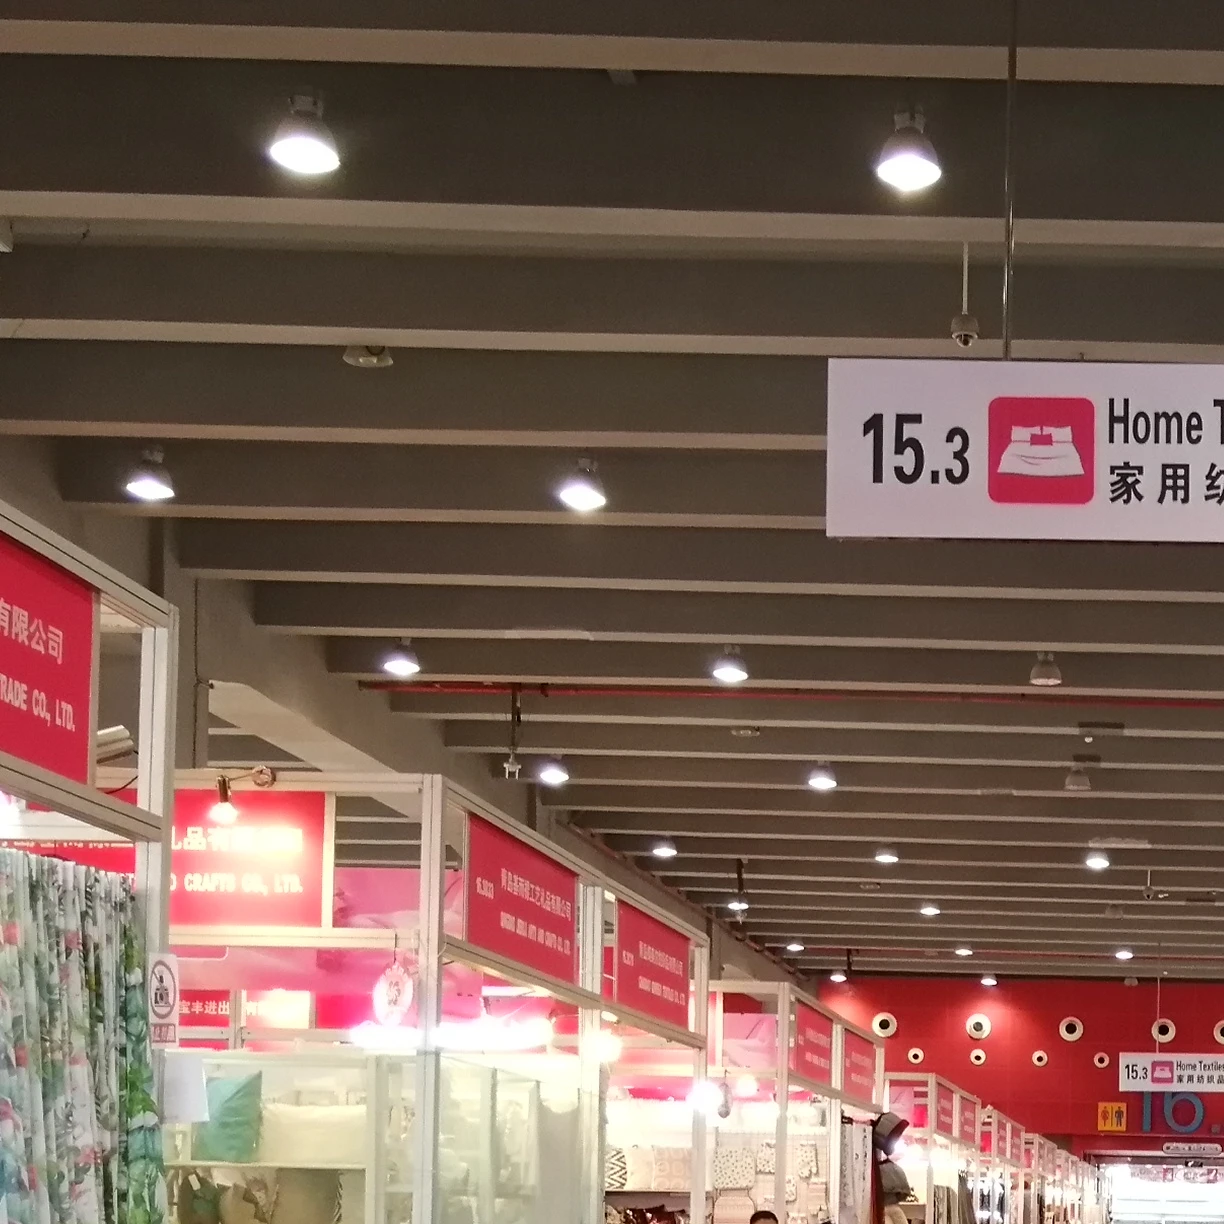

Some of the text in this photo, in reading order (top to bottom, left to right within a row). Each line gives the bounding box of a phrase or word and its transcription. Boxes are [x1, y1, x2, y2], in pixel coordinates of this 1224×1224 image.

[1107, 397, 1203, 445] Home
[863, 413, 970, 485] 15.3
[0, 597, 63, 665] 有限公司
[55, 698, 76, 732] LTD.
[1124, 1064, 1148, 1080] 15.3
[1176, 1060, 1197, 1071] Home
